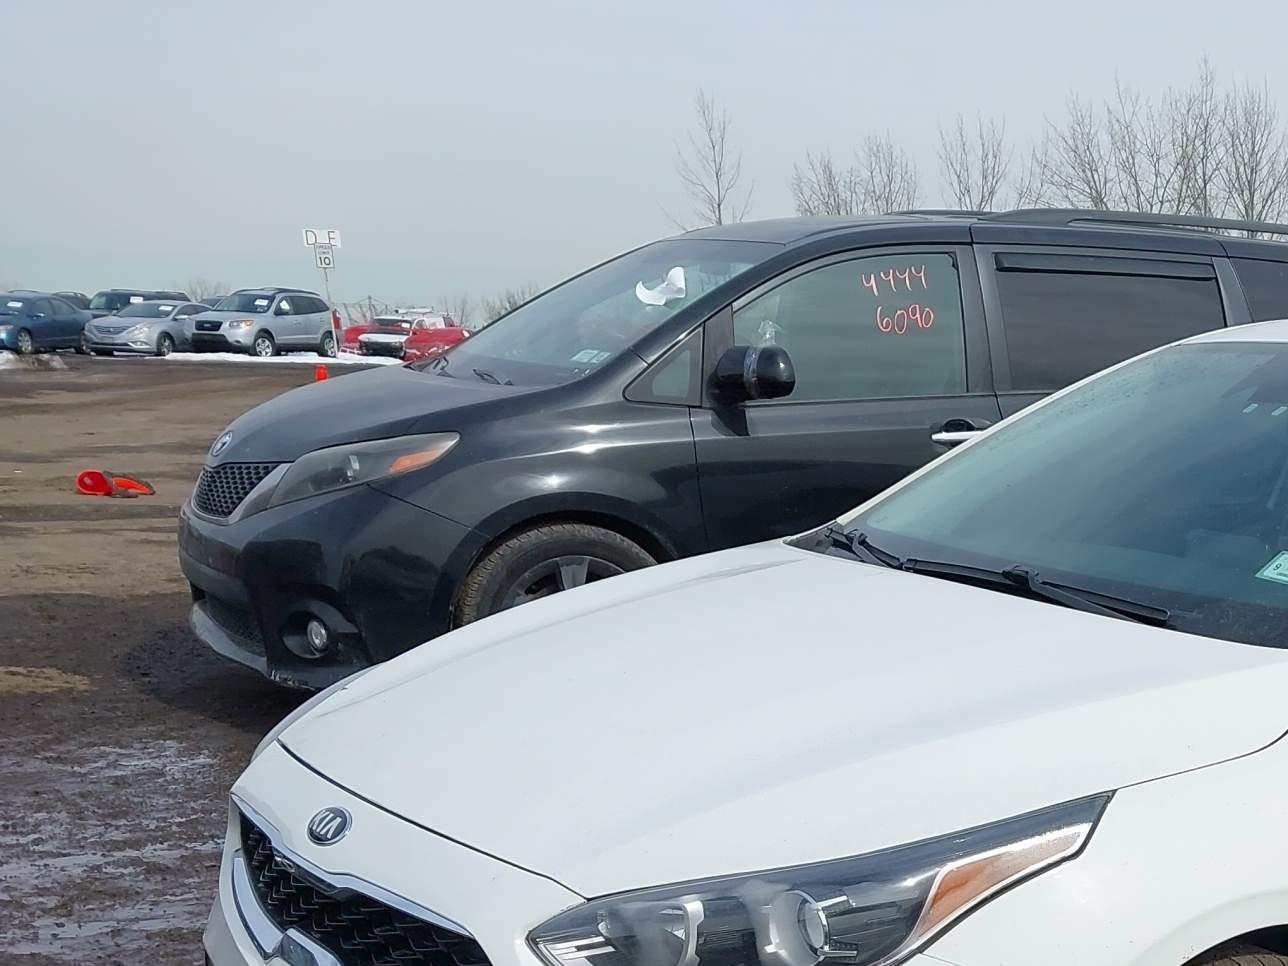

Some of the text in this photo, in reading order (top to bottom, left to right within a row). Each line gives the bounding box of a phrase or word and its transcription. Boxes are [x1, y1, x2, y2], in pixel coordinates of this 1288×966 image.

[305, 230, 337, 247] D E
[319, 256, 331, 266] 10
[861, 264, 928, 297] 4444
[876, 303, 935, 335] 6090
[309, 809, 343, 839] KIA
